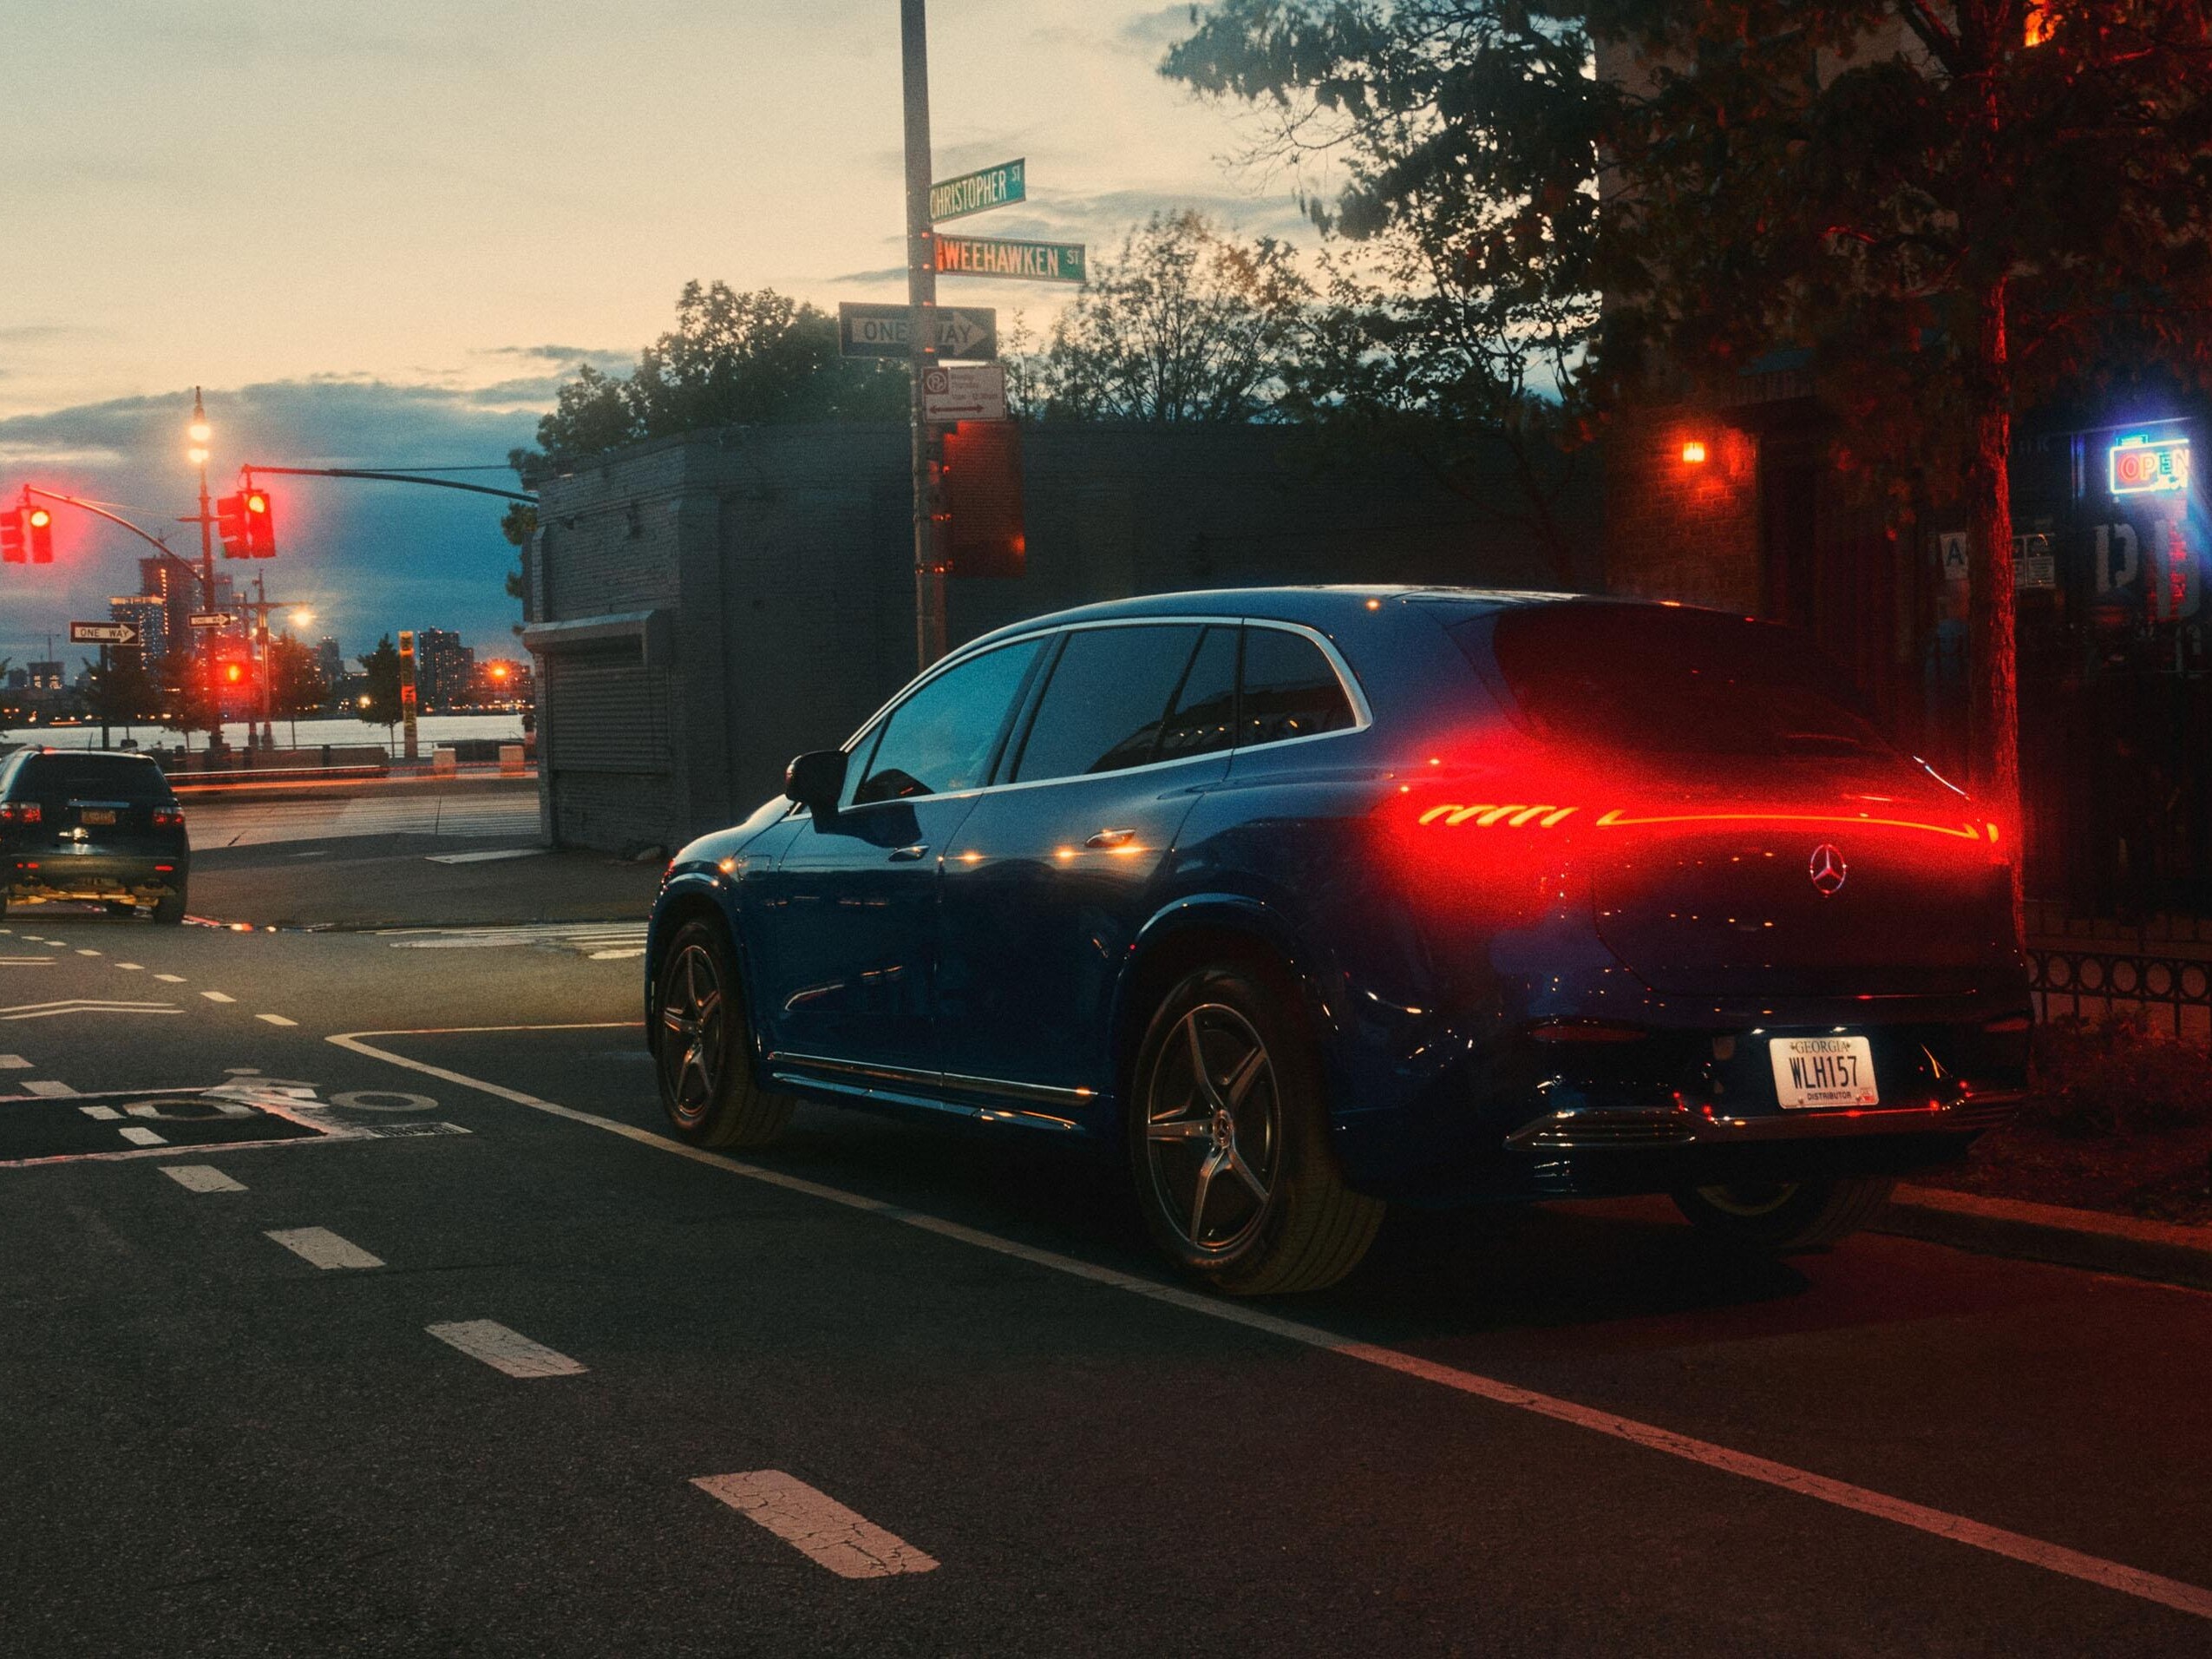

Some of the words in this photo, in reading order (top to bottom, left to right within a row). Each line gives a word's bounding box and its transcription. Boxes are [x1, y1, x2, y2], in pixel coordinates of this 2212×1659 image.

[930, 170, 1006, 219] CHRISTOPHER
[1012, 165, 1021, 181] ST
[944, 240, 1058, 277] WEEHAWKEN
[1067, 249, 1079, 265] ST
[864, 321, 907, 341] ONE
[2117, 449, 2189, 482] OPEN
[109, 629, 129, 638] WAY
[1795, 1040, 1849, 1053] GEORGIA
[1789, 1056, 1858, 1089] WLH157
[1807, 1092, 1852, 1101] DISTRIBUTOR
